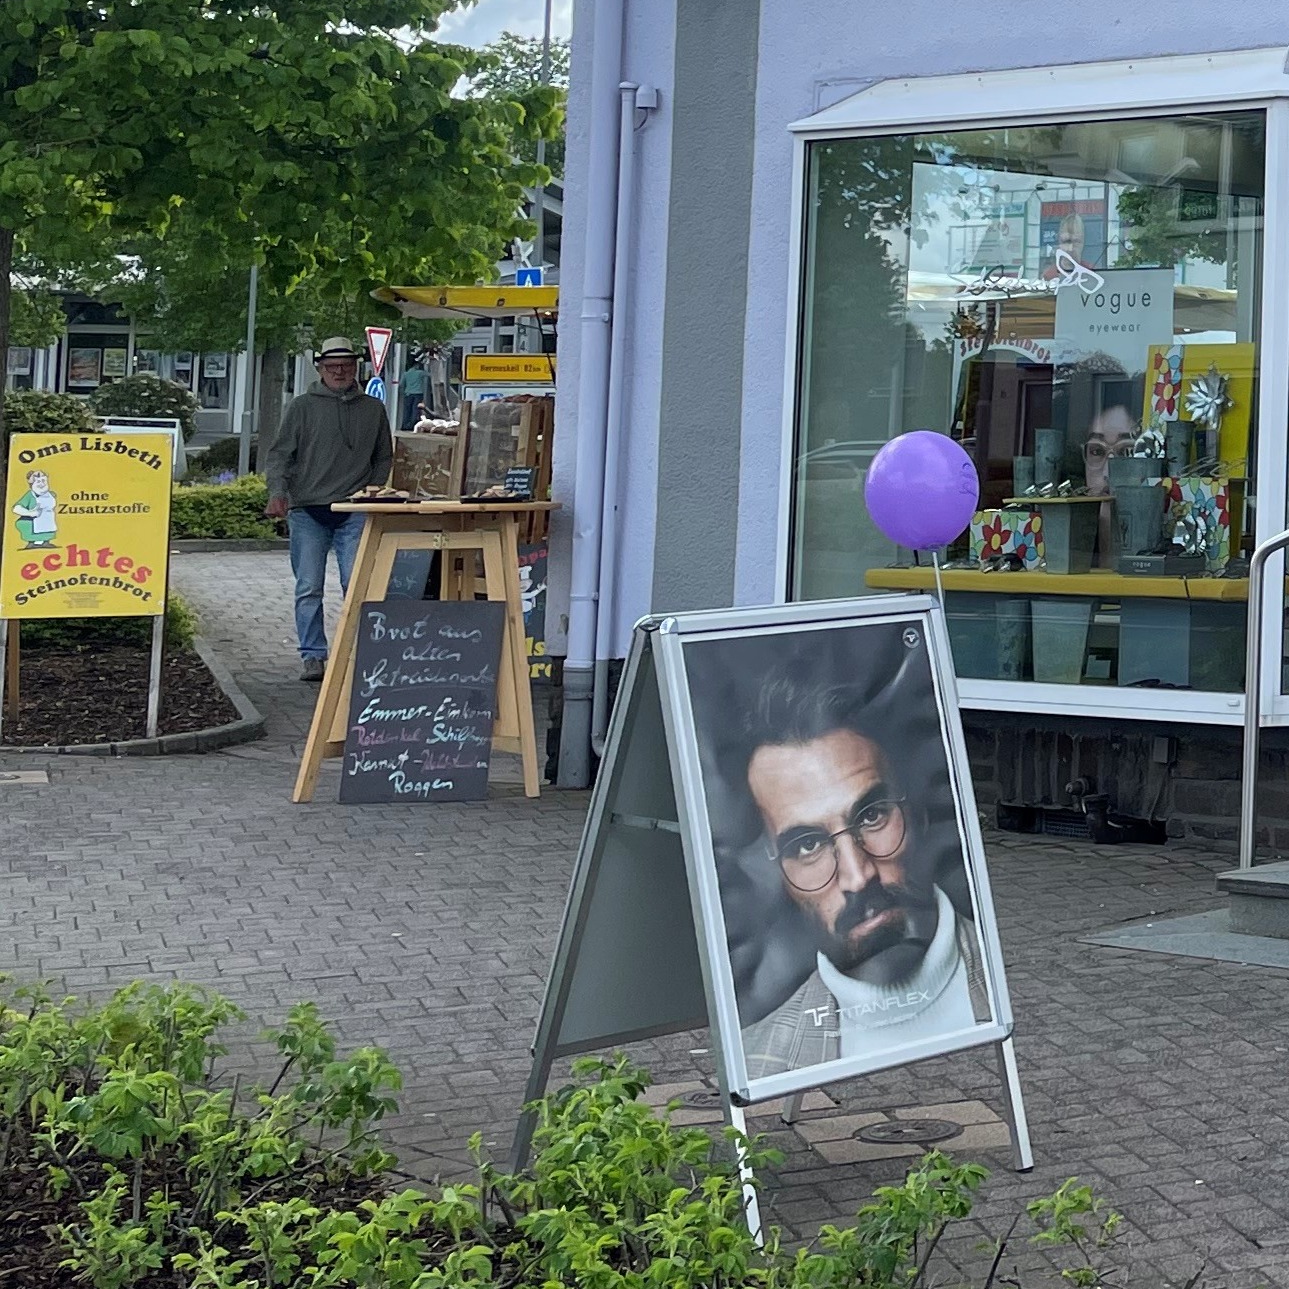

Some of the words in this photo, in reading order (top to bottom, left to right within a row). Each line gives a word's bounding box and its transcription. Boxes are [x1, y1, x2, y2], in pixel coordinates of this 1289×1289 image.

[1080, 291, 1152, 314] vogue
[1089, 322, 1142, 336] eyewear
[18, 441, 72, 464] Oma
[80, 437, 163, 470] Lisbeth
[58, 502, 151, 515] Zusatzstoffe
[71, 490, 109, 501] ohne
[20, 543, 153, 584] echtes
[15, 573, 153, 606] Steinofenbrot
[388, 770, 454, 798] Roggen
[835, 989, 931, 1020] TITANFLEX
